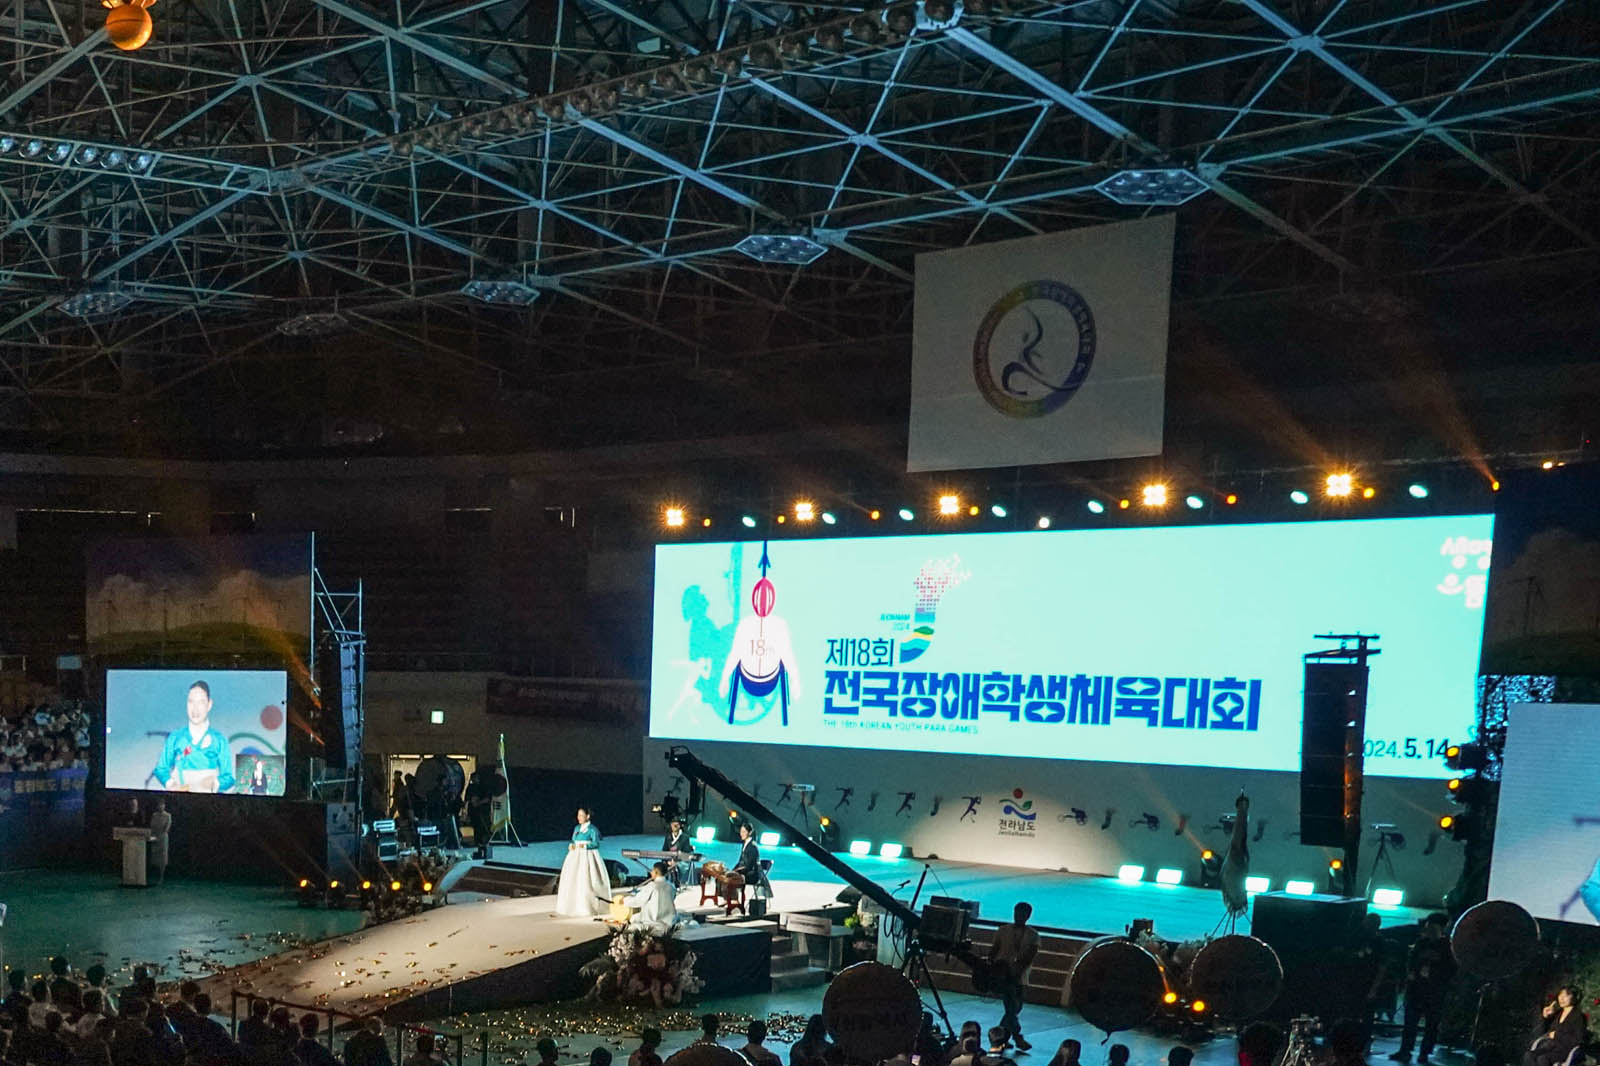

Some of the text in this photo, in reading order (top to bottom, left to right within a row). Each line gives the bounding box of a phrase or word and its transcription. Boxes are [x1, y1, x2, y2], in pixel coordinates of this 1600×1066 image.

[824, 637, 895, 668] 제18회
[823, 671, 1263, 732] 전국장애학생체육대회
[999, 819, 1036, 832] 전라남도
